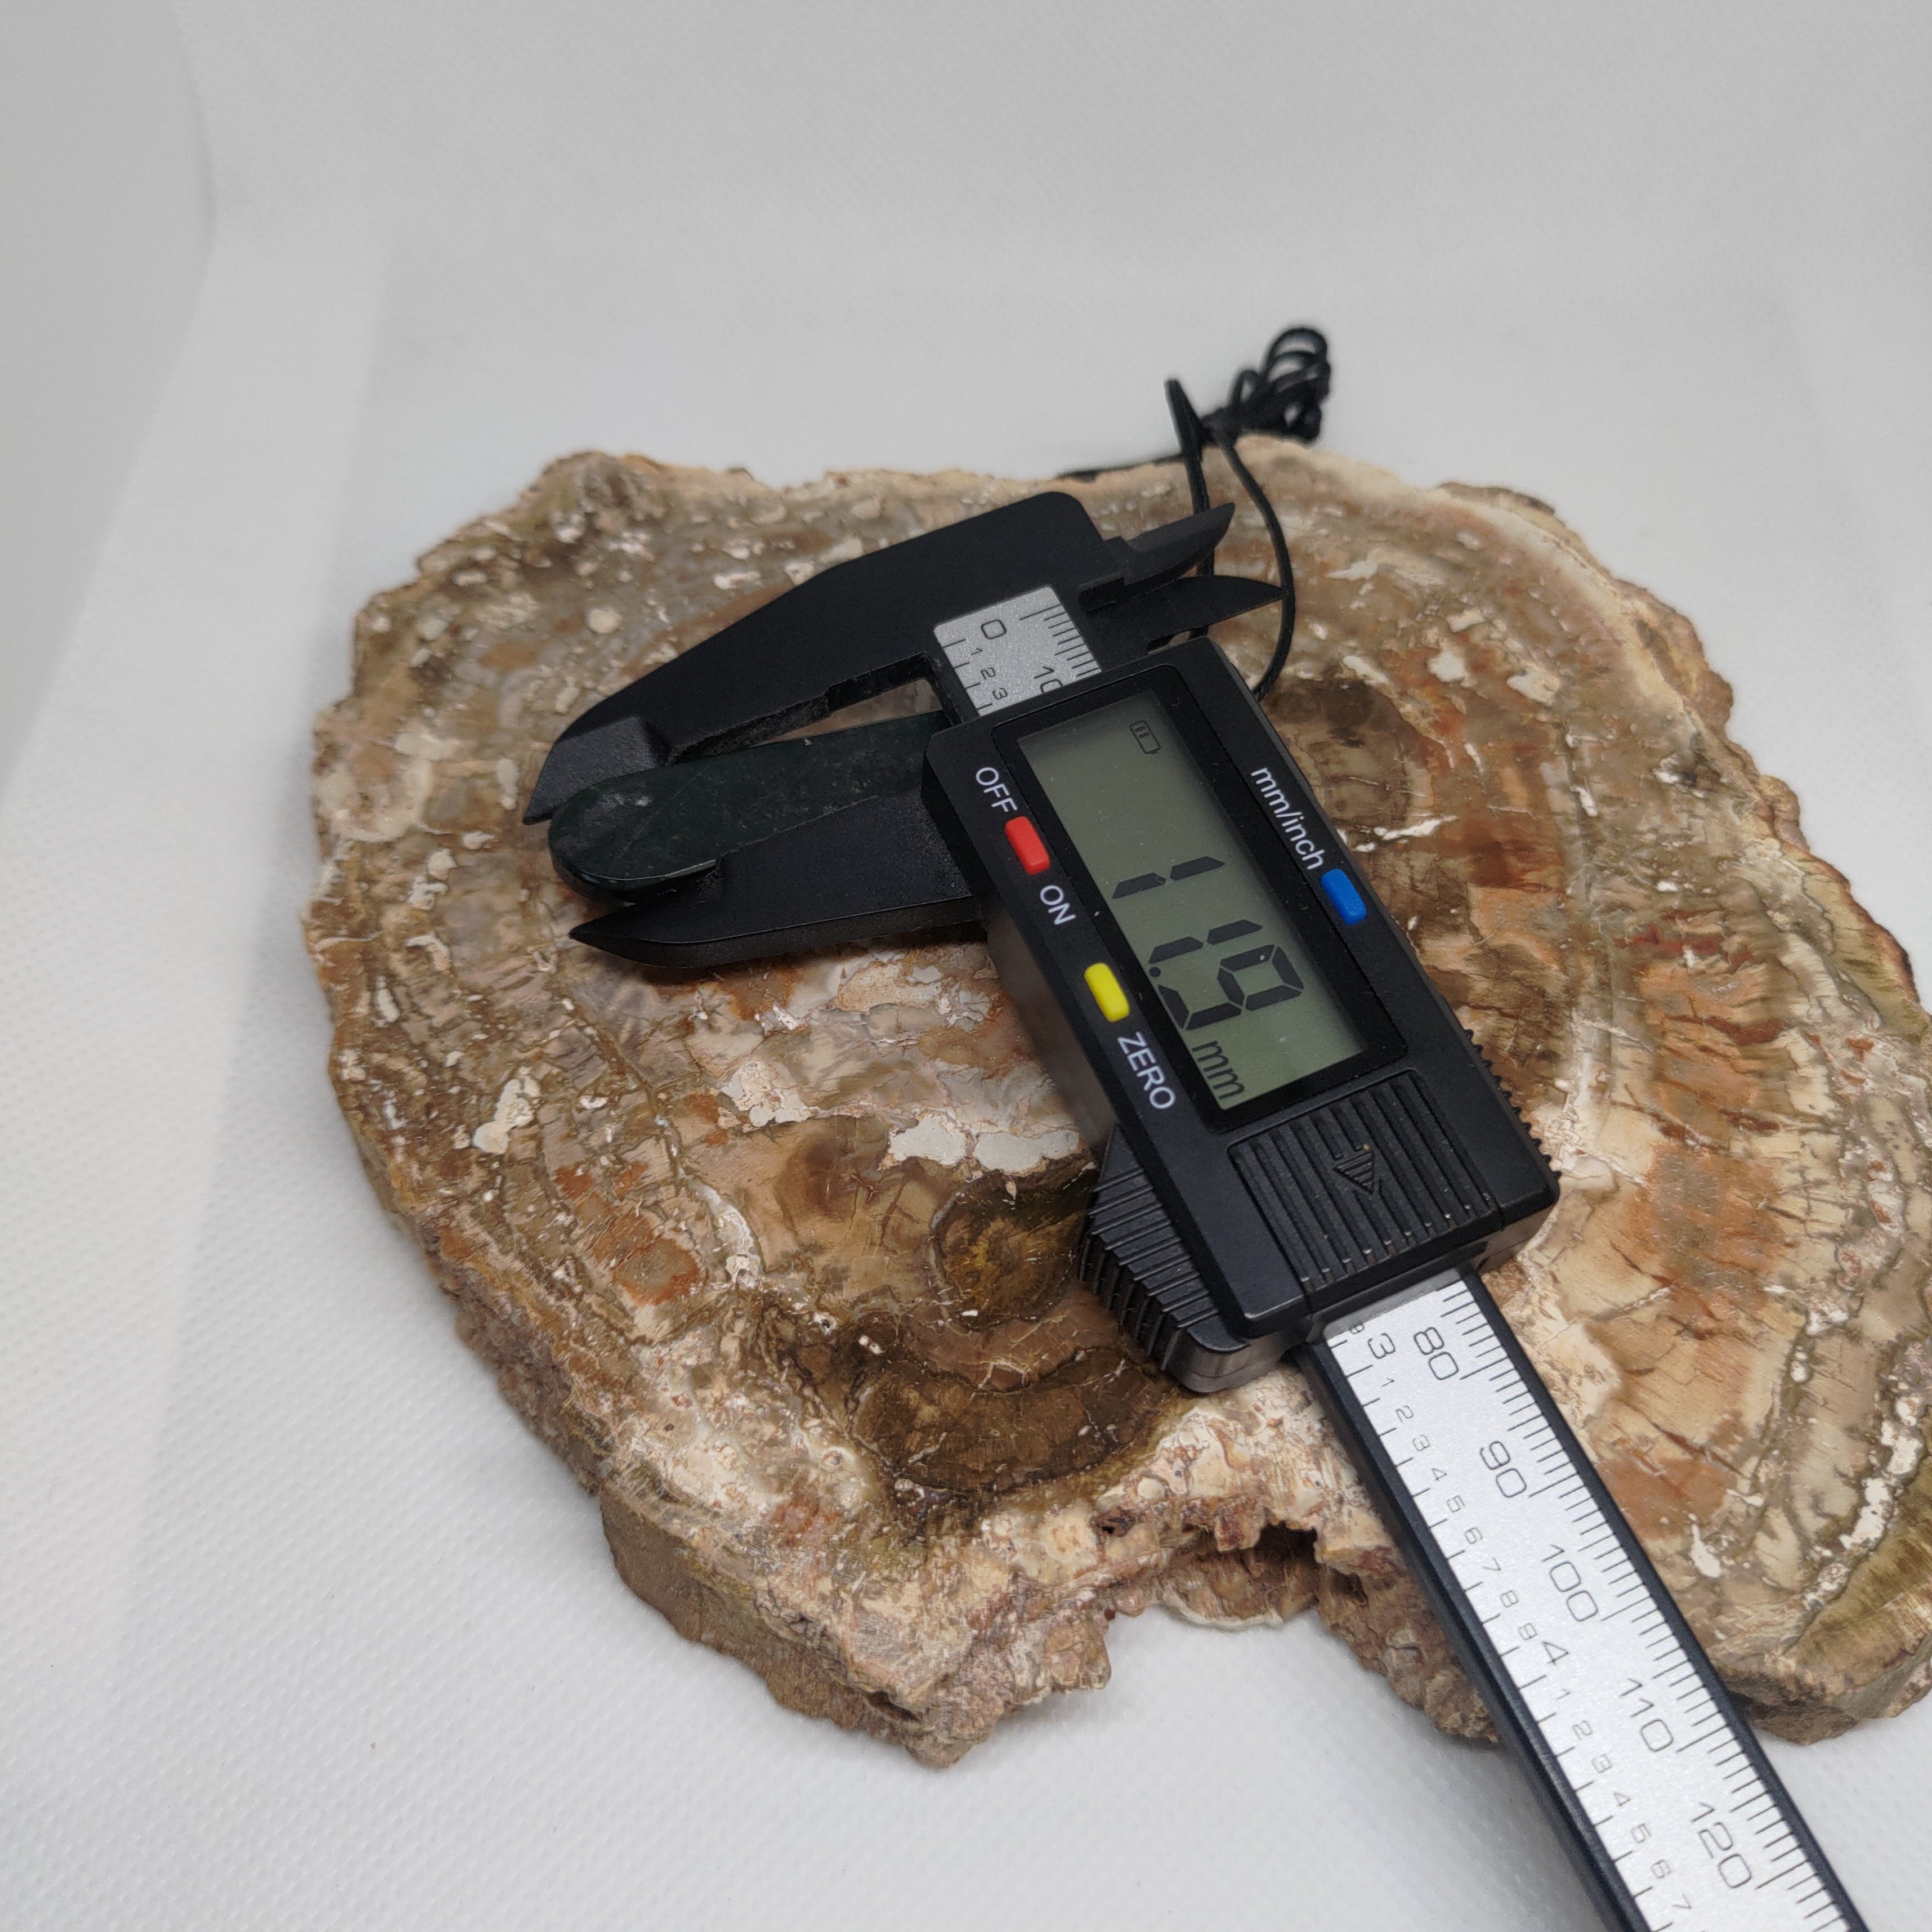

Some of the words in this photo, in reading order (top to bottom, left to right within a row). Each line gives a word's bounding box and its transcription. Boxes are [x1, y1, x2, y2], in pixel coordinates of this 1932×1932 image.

[981, 619, 1007, 639] 0
[981, 667, 996, 680] 2
[992, 688, 1008, 700] 3
[976, 767, 1018, 813] OFF
[1251, 768, 1324, 870] mm/inch
[1040, 885, 1076, 925] ON
[1117, 1031, 1176, 1110] ZERO
[1192, 1040, 1245, 1100] mm
[1368, 1332, 1396, 1359] 3
[1381, 1377, 1395, 1388] 1
[1396, 1405, 1414, 1423] 2
[1412, 1434, 1431, 1452] 3
[1430, 1466, 1447, 1482] 4
[1446, 1495, 1466, 1513] 5
[1464, 1527, 1483, 1544] 6
[1482, 1557, 1501, 1572] 7
[1413, 1326, 1459, 1380] 80
[1480, 1441, 1527, 1498] 90
[1542, 1544, 1599, 1622] 100
[1619, 1678, 1674, 1752] 110
[1691, 1802, 1752, 1889] 120
[1499, 1590, 1519, 1608] 8
[1542, 1641, 1569, 1665] 4
[1572, 1720, 1593, 1741] 2
